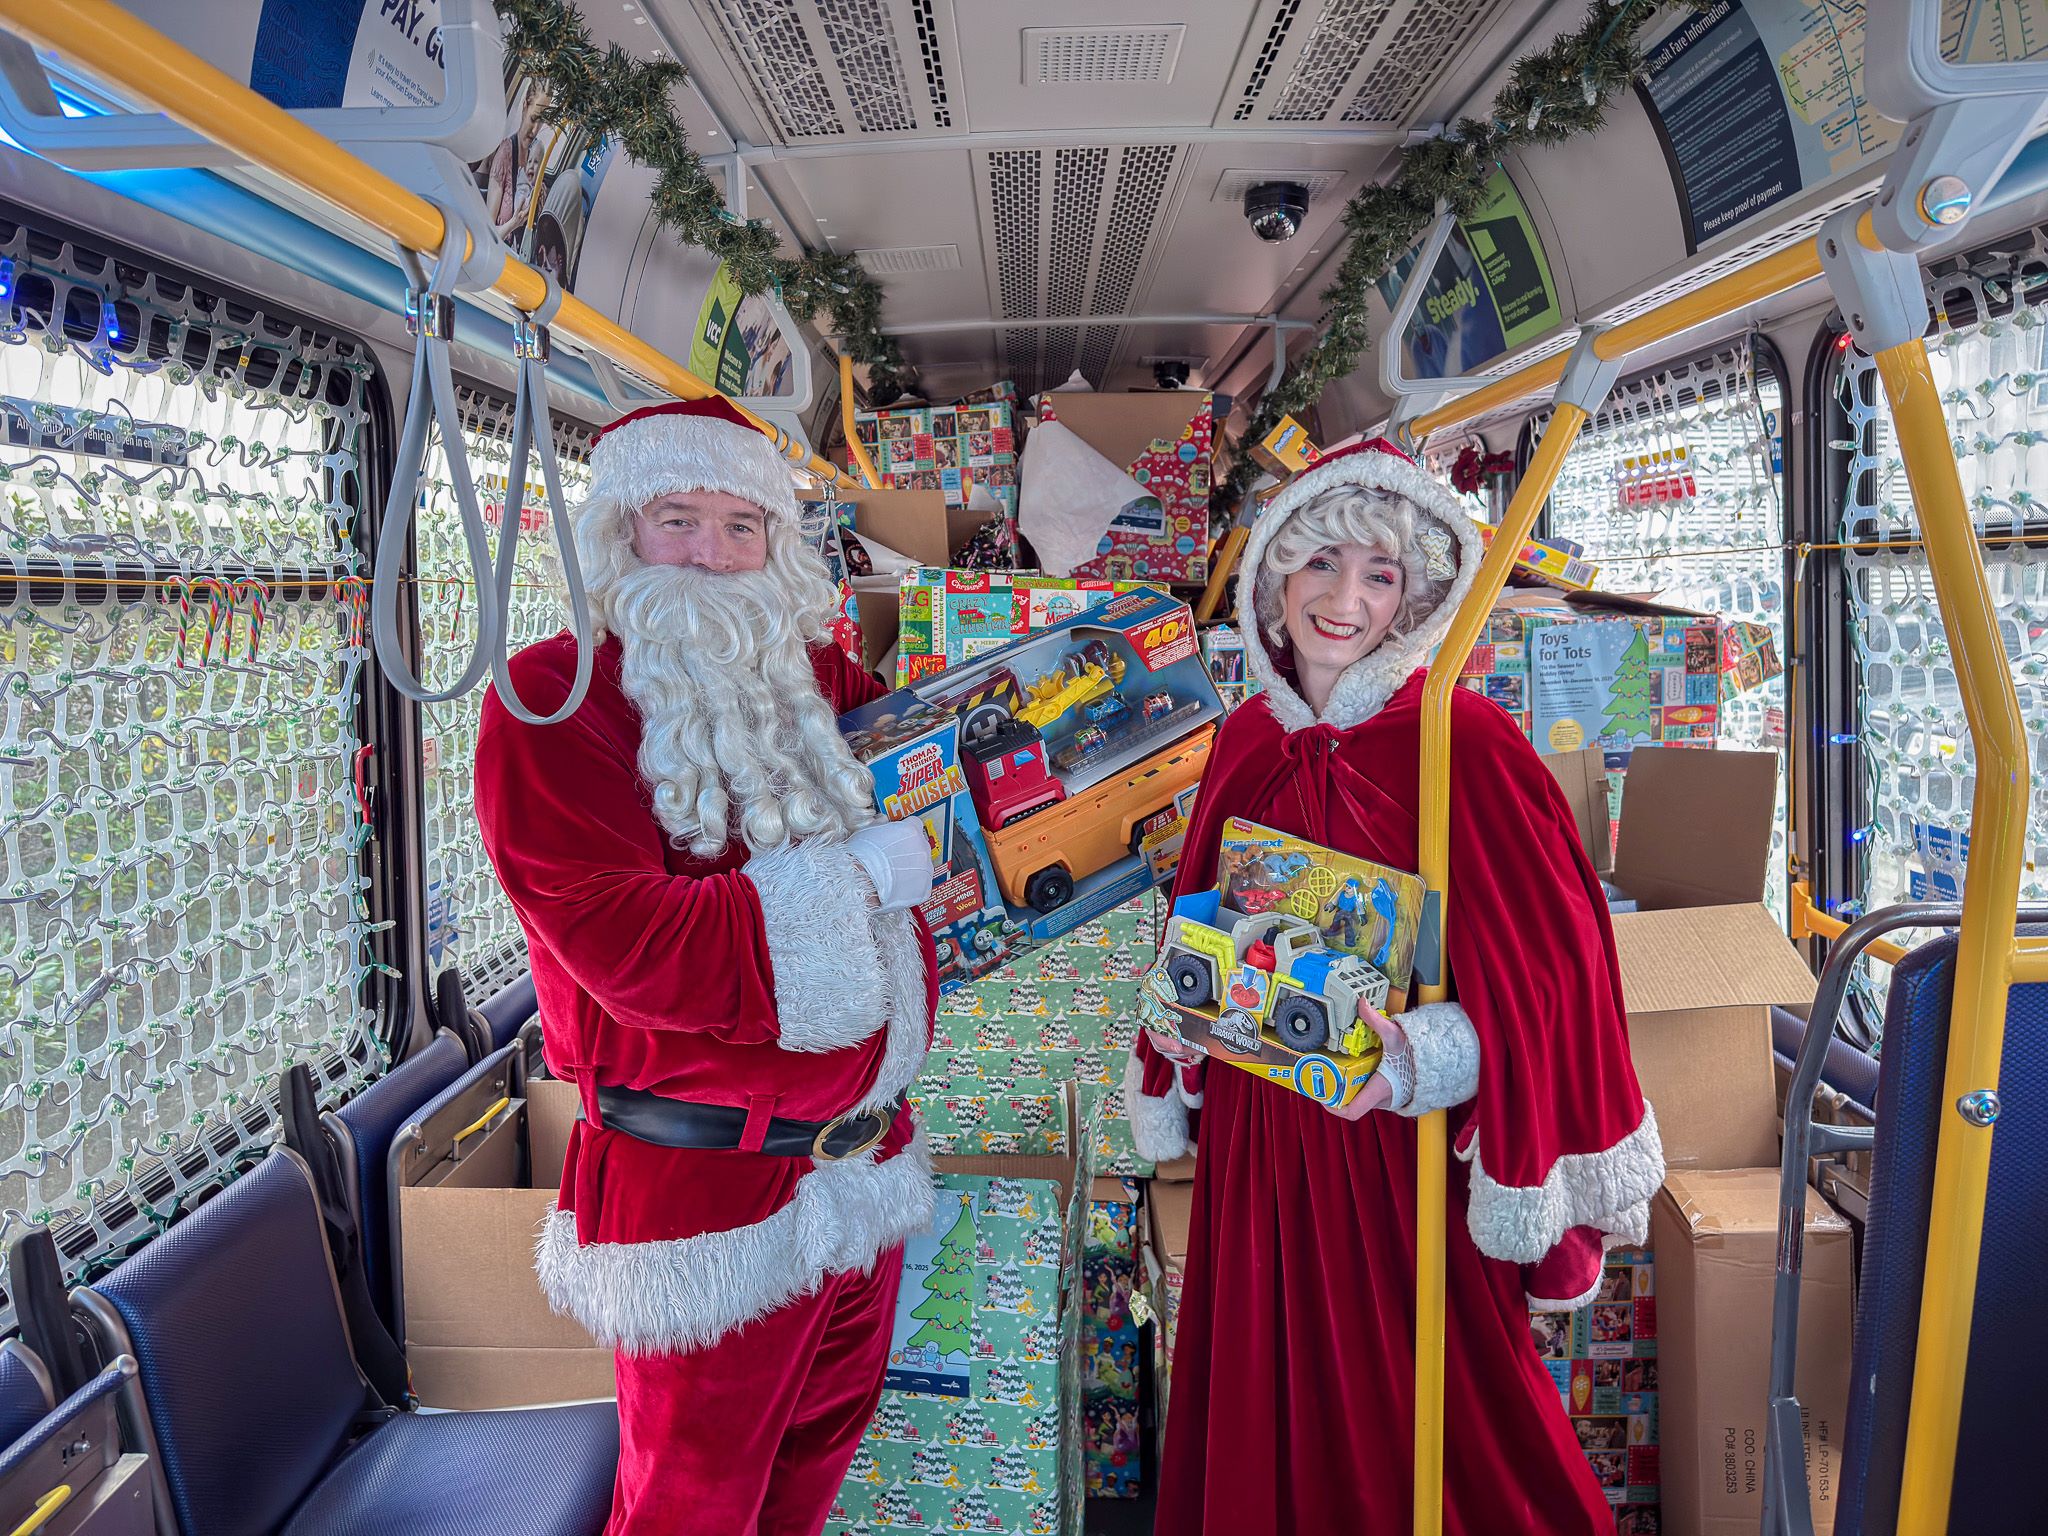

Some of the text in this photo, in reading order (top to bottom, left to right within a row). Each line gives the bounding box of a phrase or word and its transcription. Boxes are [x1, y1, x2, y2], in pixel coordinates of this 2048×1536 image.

[1669, 36, 1688, 56] Fare
[1684, 0, 1730, 42] Information
[1704, 216, 1721, 232] Please
[1720, 208, 1734, 222] keep
[1735, 198, 1750, 217] proof
[1757, 181, 1782, 205] payment
[706, 318, 721, 344] VCC
[136, 437, 142, 447] in
[950, 597, 987, 610] CRAZY
[1144, 621, 1188, 649] 40+
[1540, 633, 1569, 647] Toys
[1540, 647, 1591, 661] for Tots
[900, 745, 937, 767] THOMAS
[912, 754, 936, 770] FRIENDS
[897, 758, 945, 796] SUPER
[884, 764, 965, 822] CRUISER
[956, 898, 977, 912] Wood
[1211, 1024, 1261, 1052] JURASSIC WORLD
[1269, 1068, 1290, 1078] 3-8
[1725, 1427, 1737, 1494] PO# 3803253
[1745, 1460, 1756, 1494] CHINA
